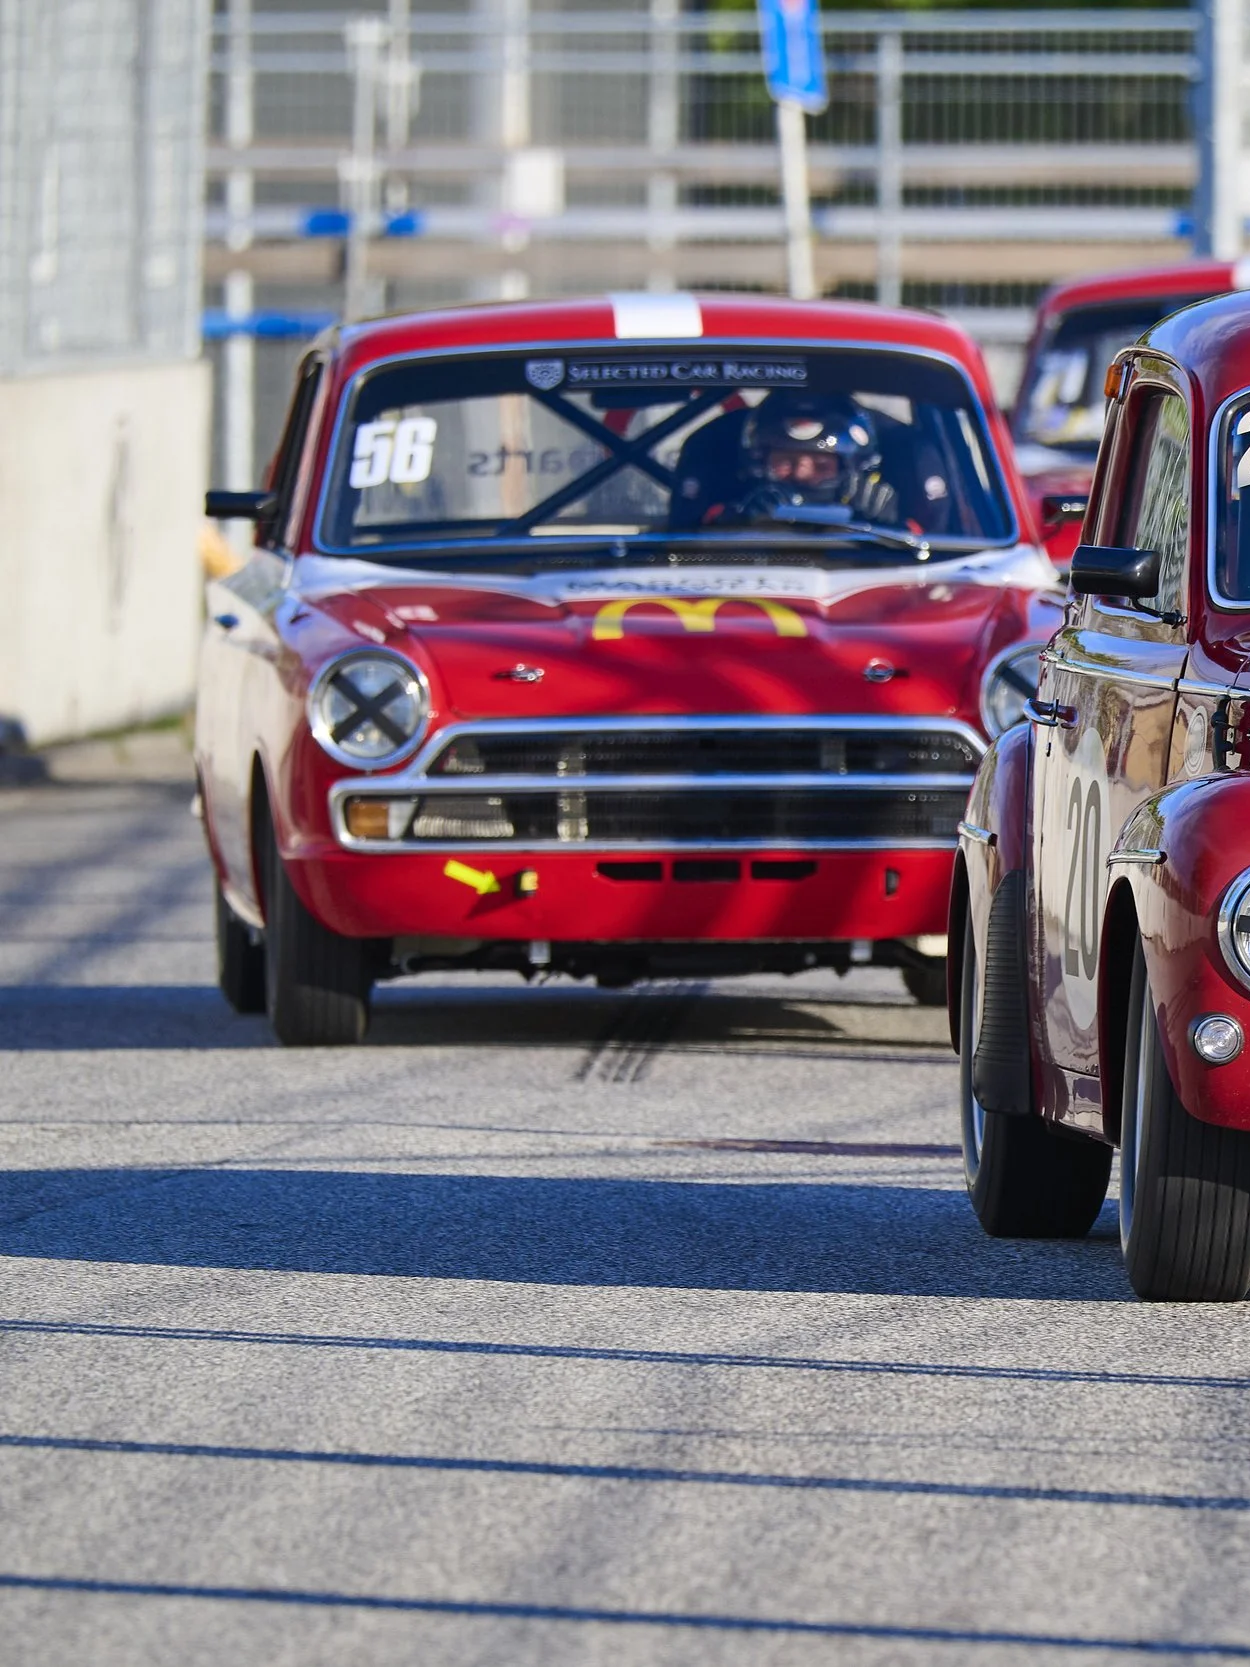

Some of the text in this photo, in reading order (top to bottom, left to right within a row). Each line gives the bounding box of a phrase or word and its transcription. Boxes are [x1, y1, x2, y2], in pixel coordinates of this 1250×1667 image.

[568, 361, 808, 381] SELECTED CAR RACING
[349, 417, 437, 489] 56
[1064, 776, 1101, 981] 20
